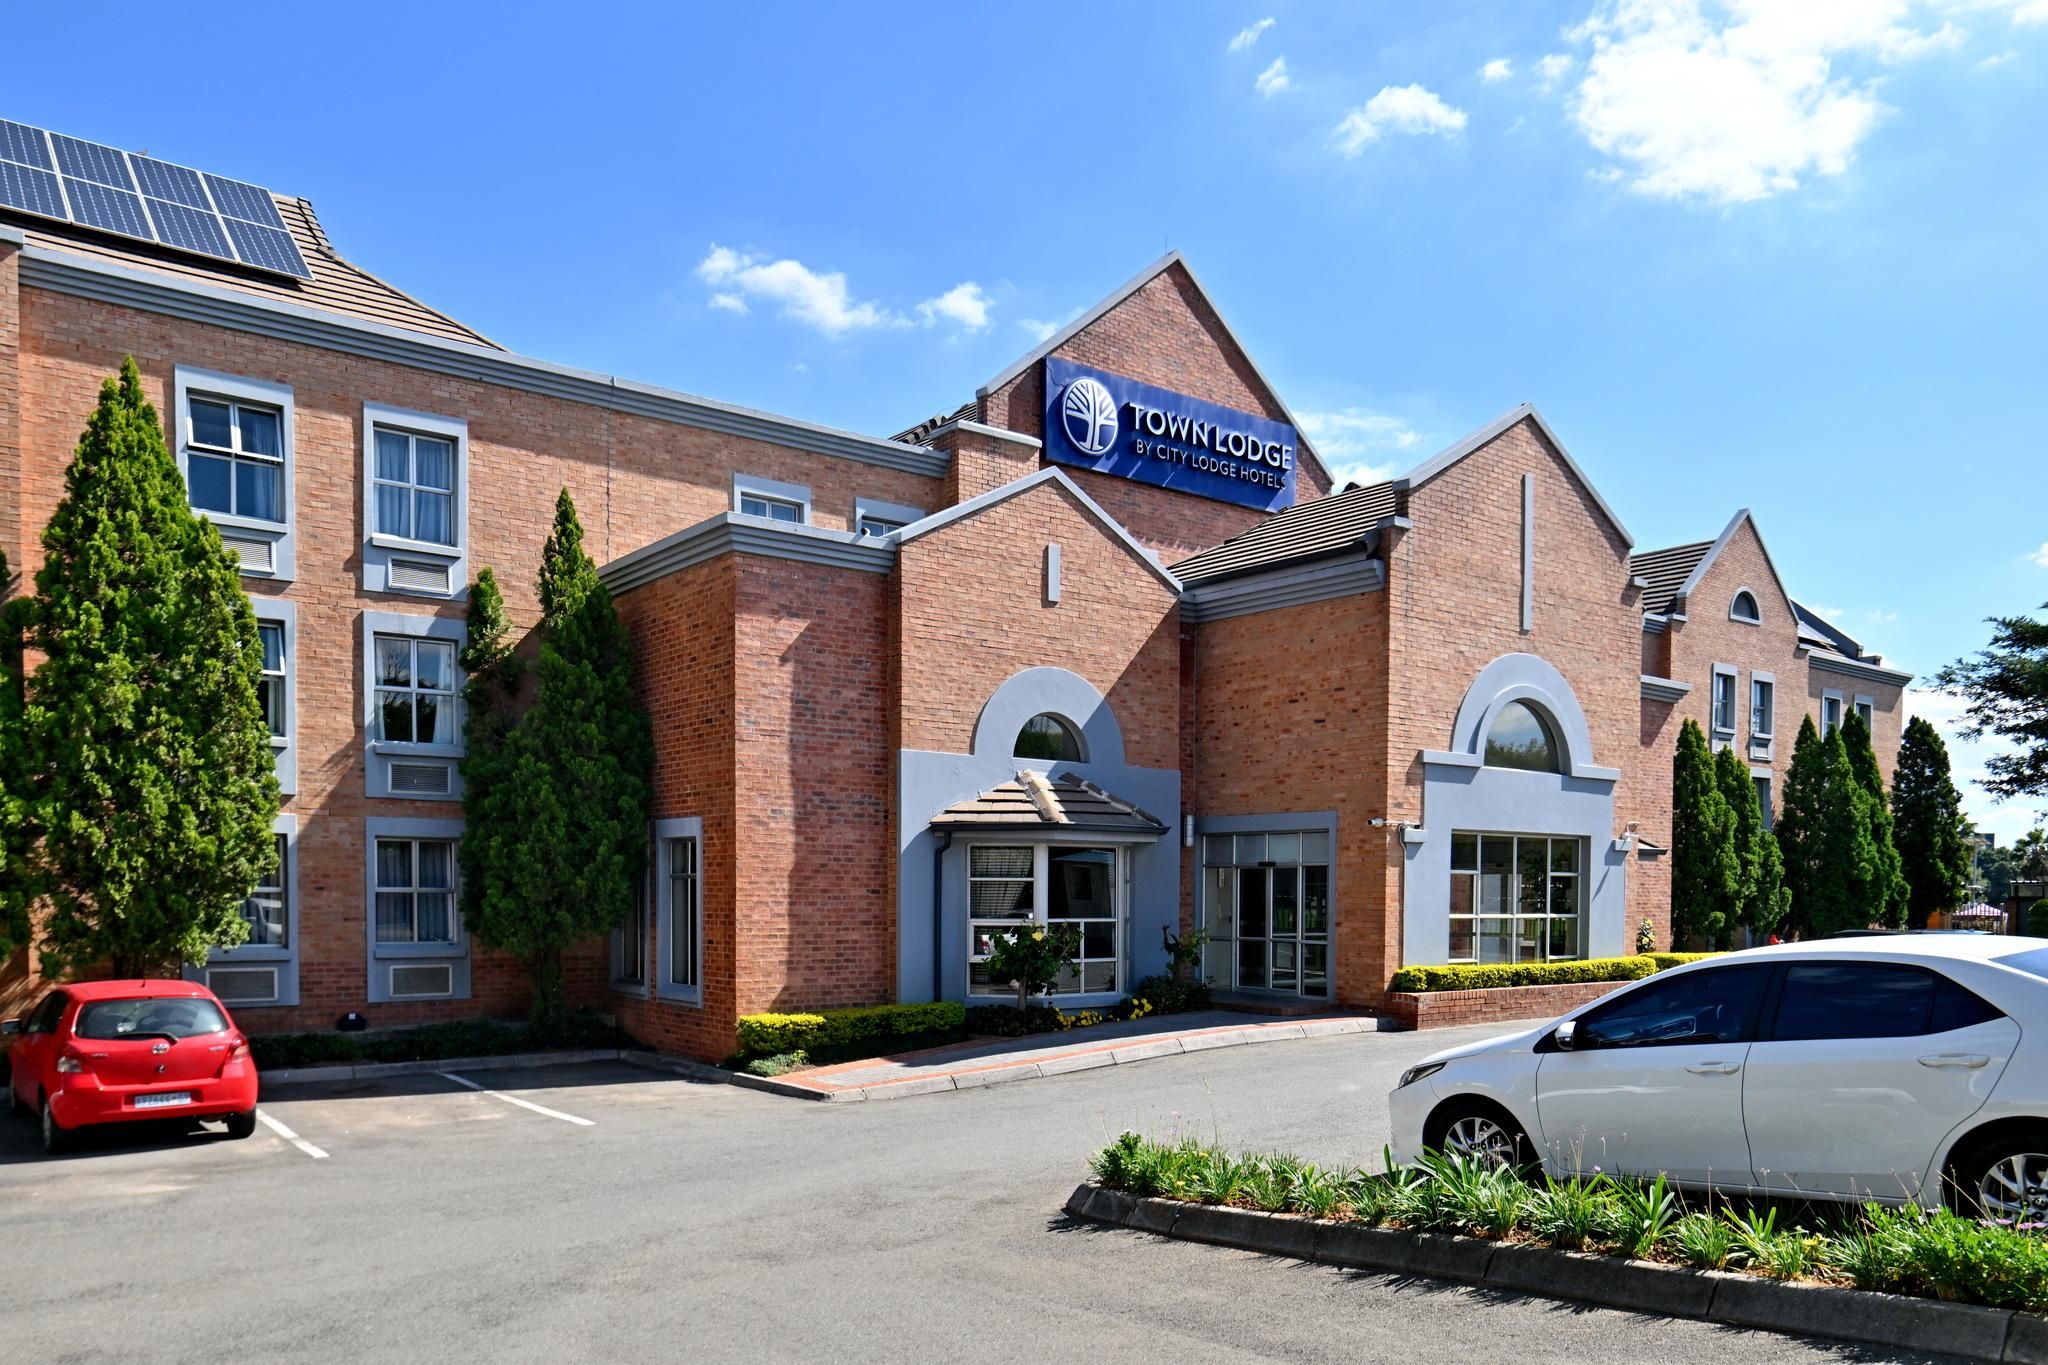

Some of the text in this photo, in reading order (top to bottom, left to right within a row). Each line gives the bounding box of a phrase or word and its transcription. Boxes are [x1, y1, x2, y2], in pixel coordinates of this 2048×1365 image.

[1129, 402, 1292, 470] TOWN LODGE
[1136, 440, 1286, 490] BY CITY LODGE HOTELS
